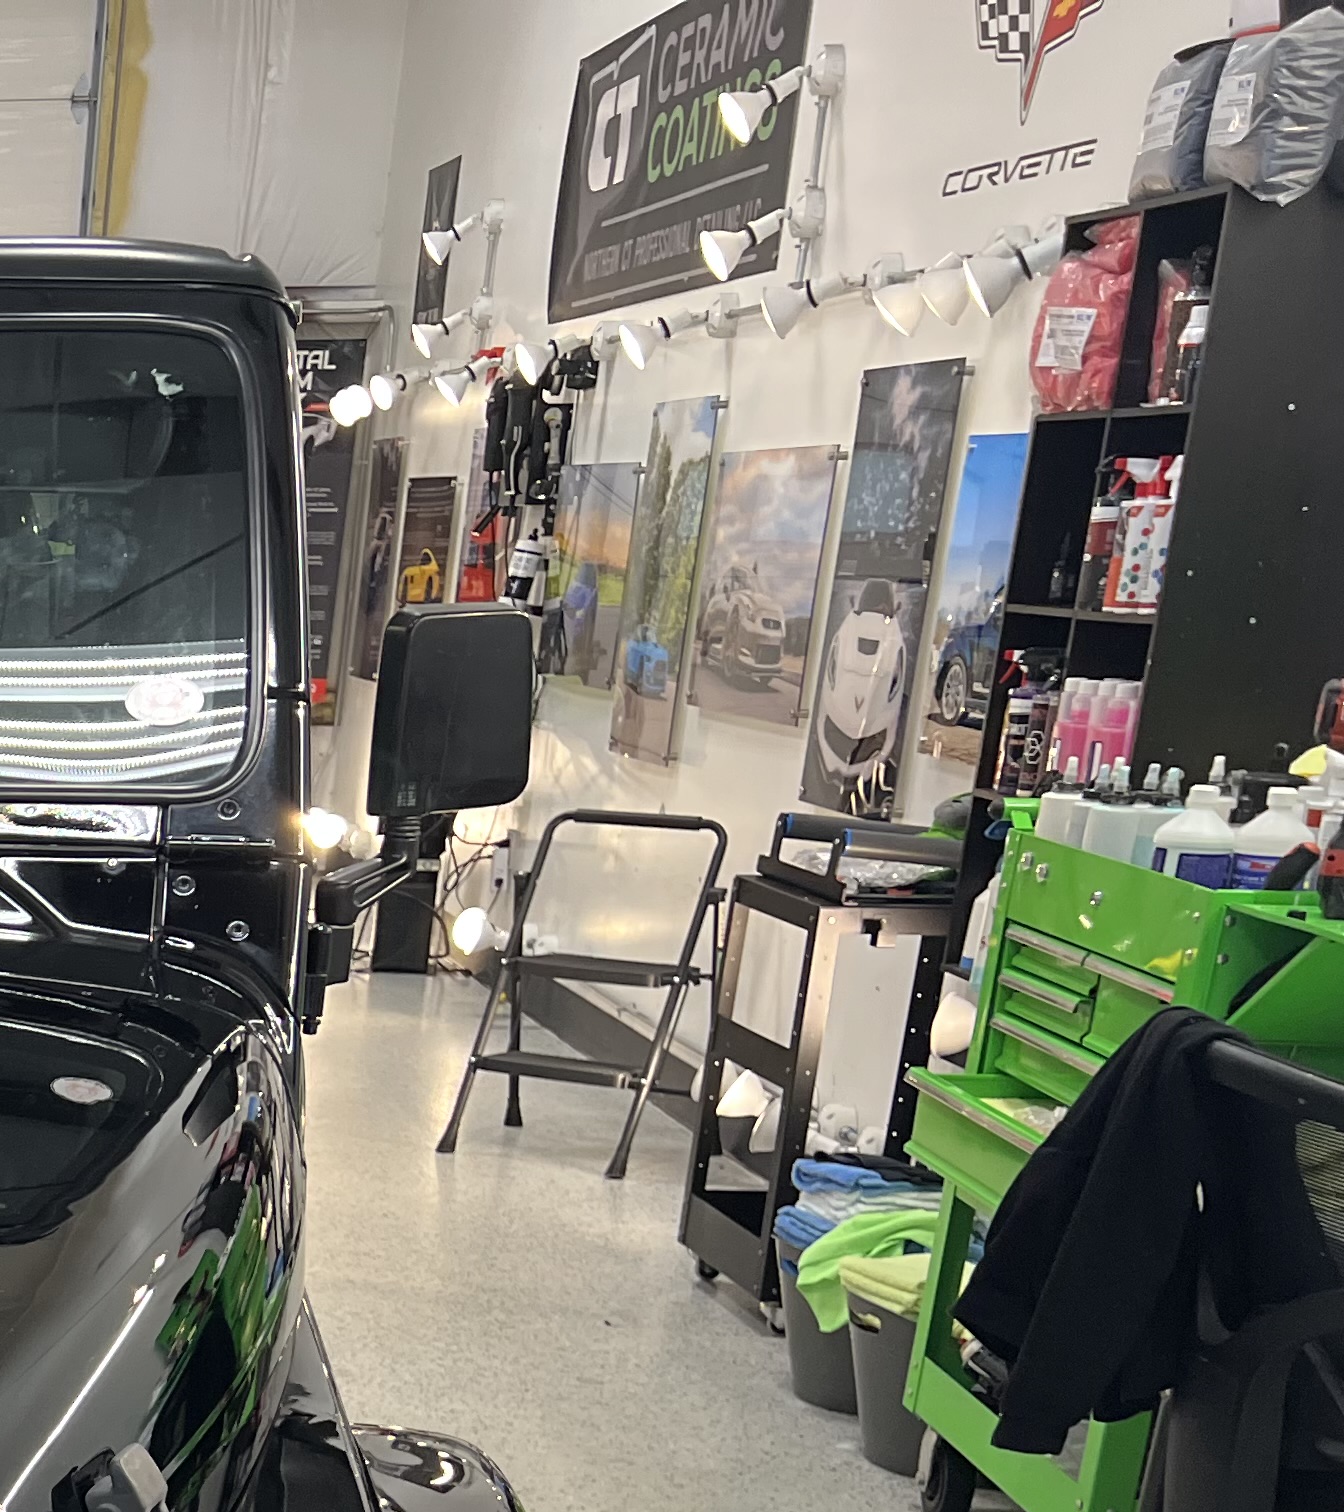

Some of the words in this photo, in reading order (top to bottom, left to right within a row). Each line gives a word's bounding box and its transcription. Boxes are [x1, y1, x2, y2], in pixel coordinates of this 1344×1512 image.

[658, 0, 784, 103] CERAMIC
[588, 75, 641, 192] CT
[942, 138, 1098, 197] CORVETTE
